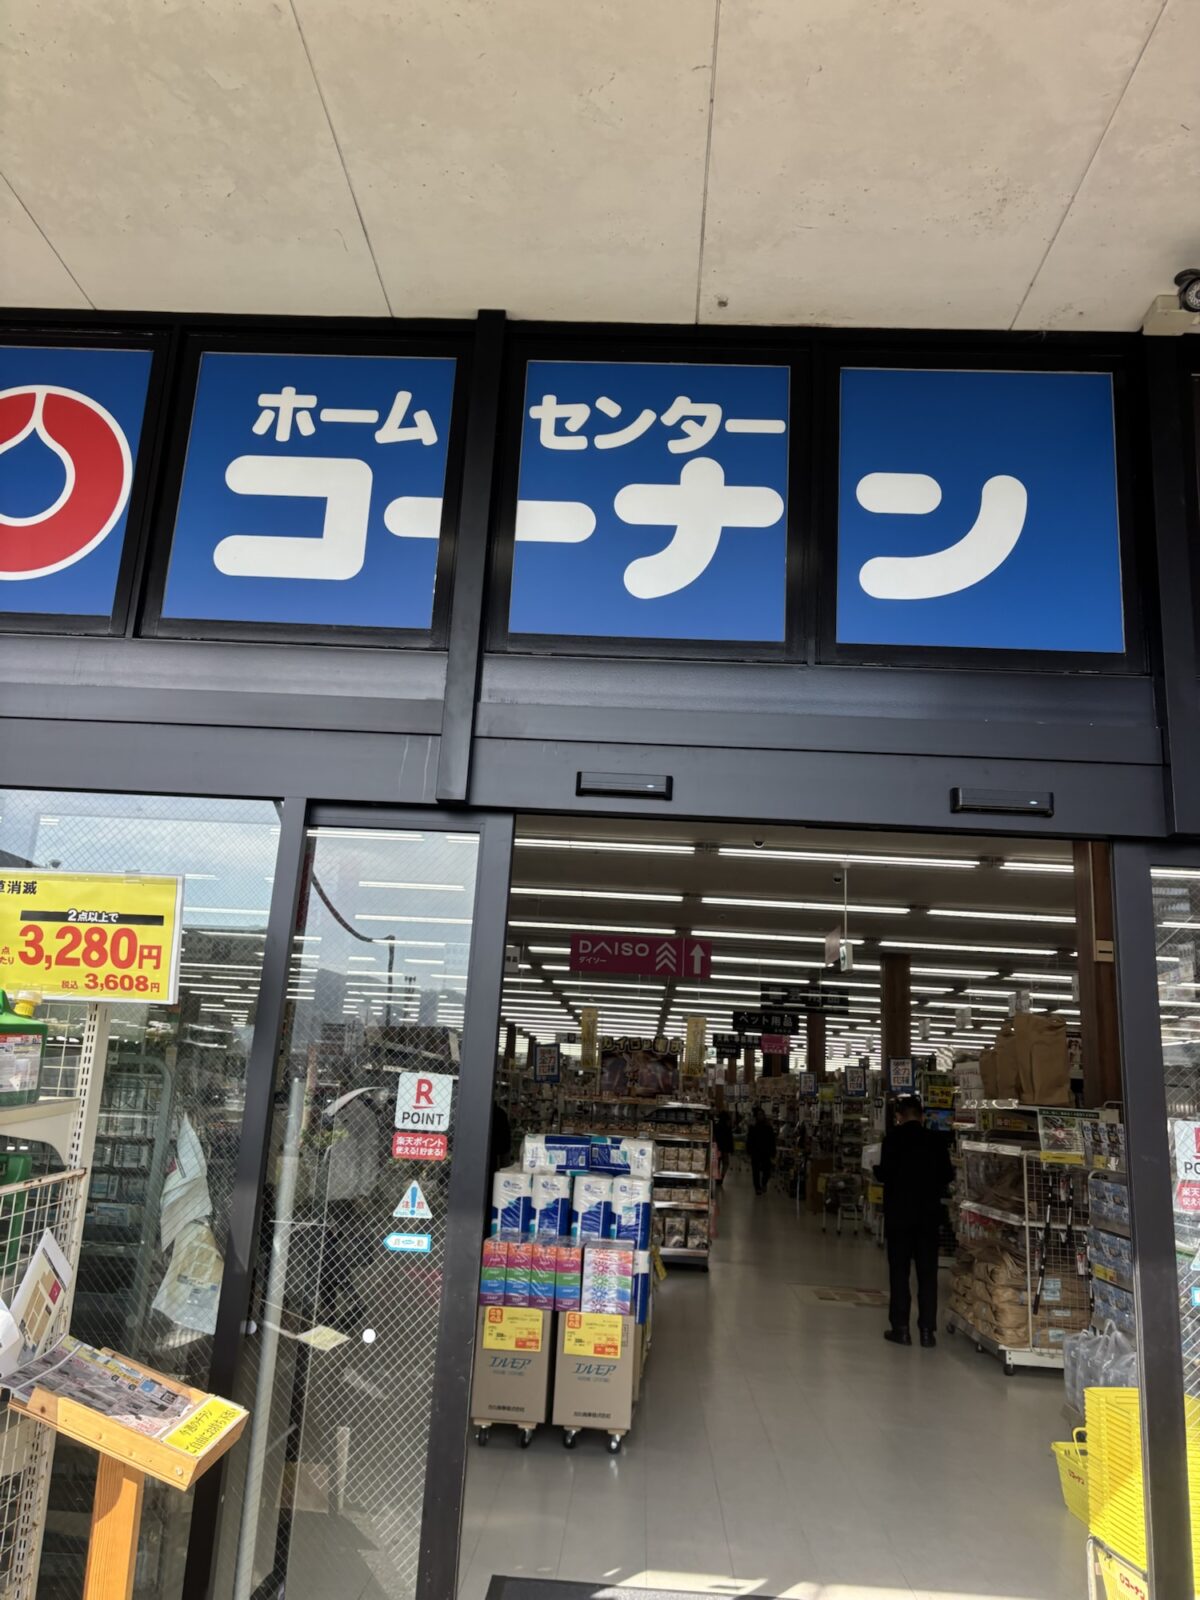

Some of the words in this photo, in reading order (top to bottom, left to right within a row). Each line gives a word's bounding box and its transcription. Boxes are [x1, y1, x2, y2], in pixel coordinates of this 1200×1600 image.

[252, 386, 438, 446] ホーム
[529, 394, 786, 454] センター
[213, 455, 1028, 600] コーナン
[67, 909, 119, 923] 2点以上で
[18, 924, 162, 970] 3,280円
[578, 939, 650, 957] DAISO
[578, 956, 607, 965] ダイソー
[61, 980, 78, 990] 税込
[84, 973, 160, 993] 3,608円
[739, 1013, 793, 1028] ペット用品
[415, 1078, 434, 1105] R
[402, 1112, 444, 1126] POINT
[396, 1136, 444, 1148] 楽天ポイント
